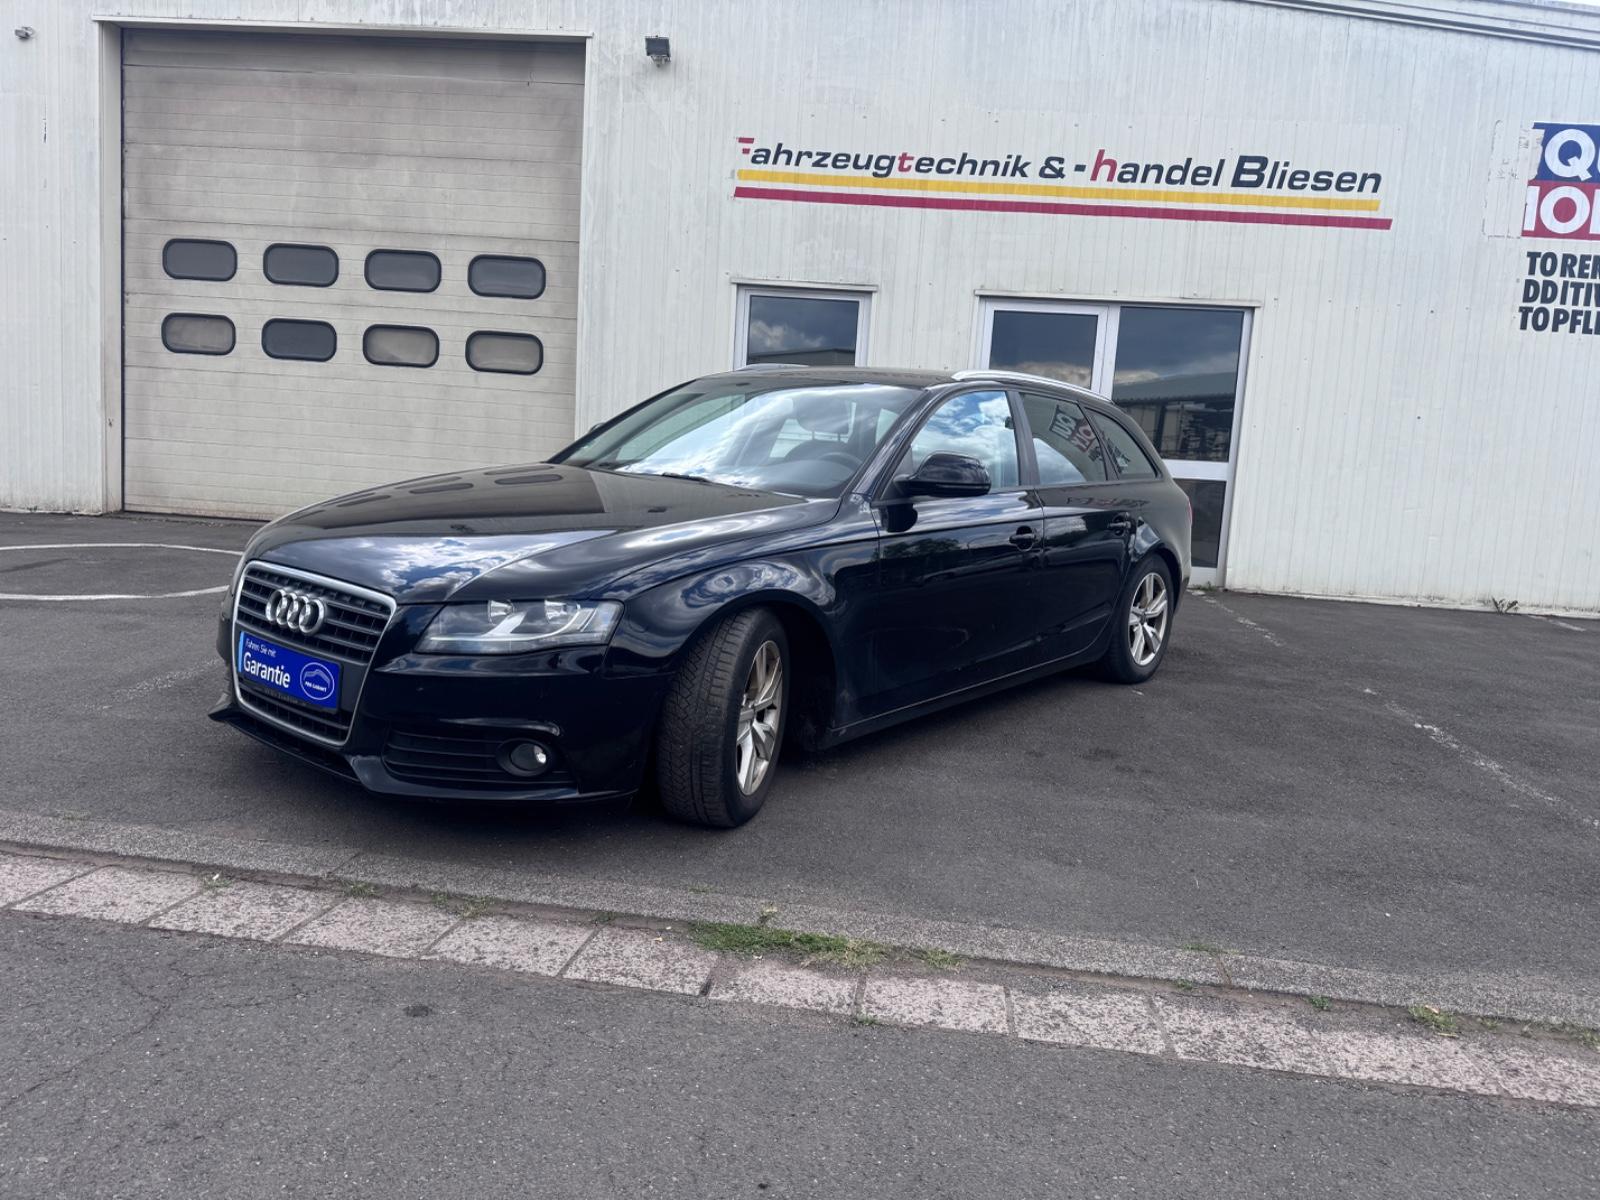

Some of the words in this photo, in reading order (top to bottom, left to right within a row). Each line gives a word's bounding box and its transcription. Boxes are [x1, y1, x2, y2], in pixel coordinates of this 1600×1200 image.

[1039, 156, 1066, 179] &
[1231, 155, 1383, 194] Bliesen
[243, 651, 291, 688] Garantie
